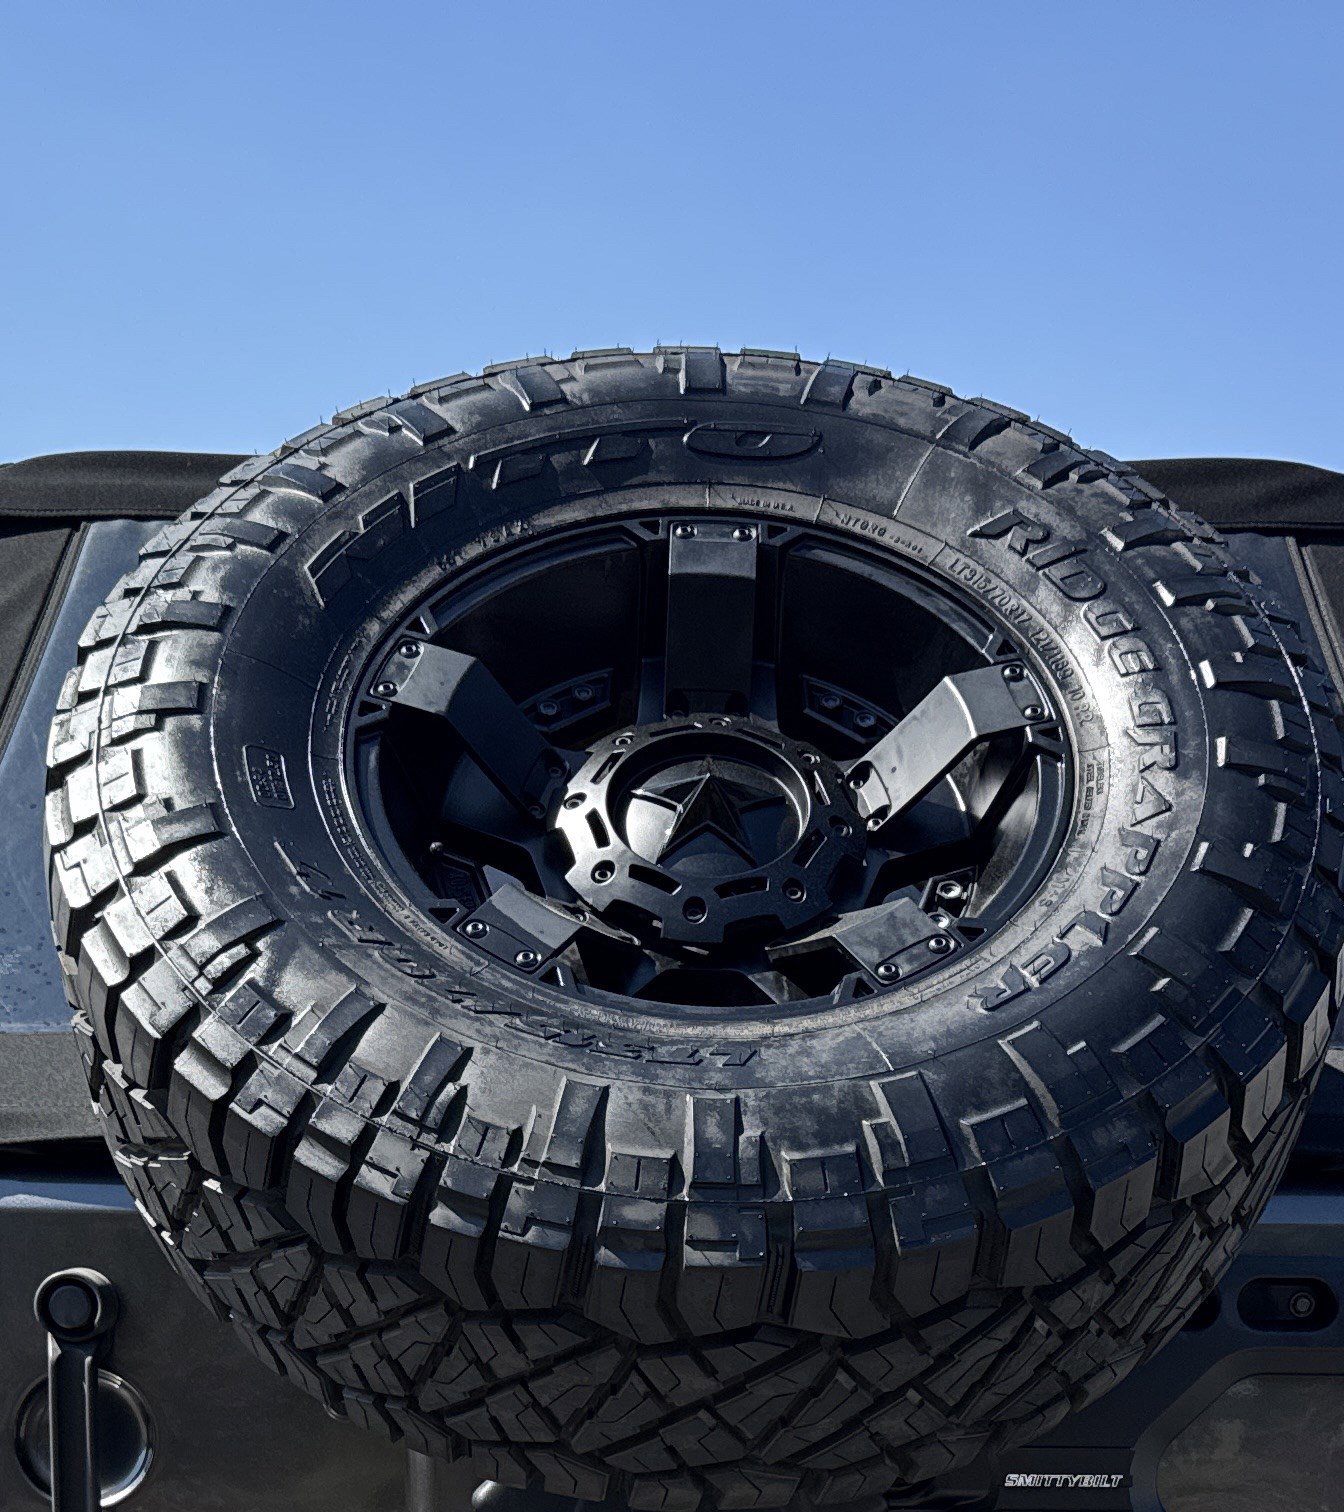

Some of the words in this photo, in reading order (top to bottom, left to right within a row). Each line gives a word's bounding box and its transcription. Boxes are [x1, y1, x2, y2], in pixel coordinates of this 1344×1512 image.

[967, 507, 1162, 679] RIDGE
[967, 680, 1180, 1013] GRAPPLER
[1004, 1472, 1124, 1489] SMITTYBILT
